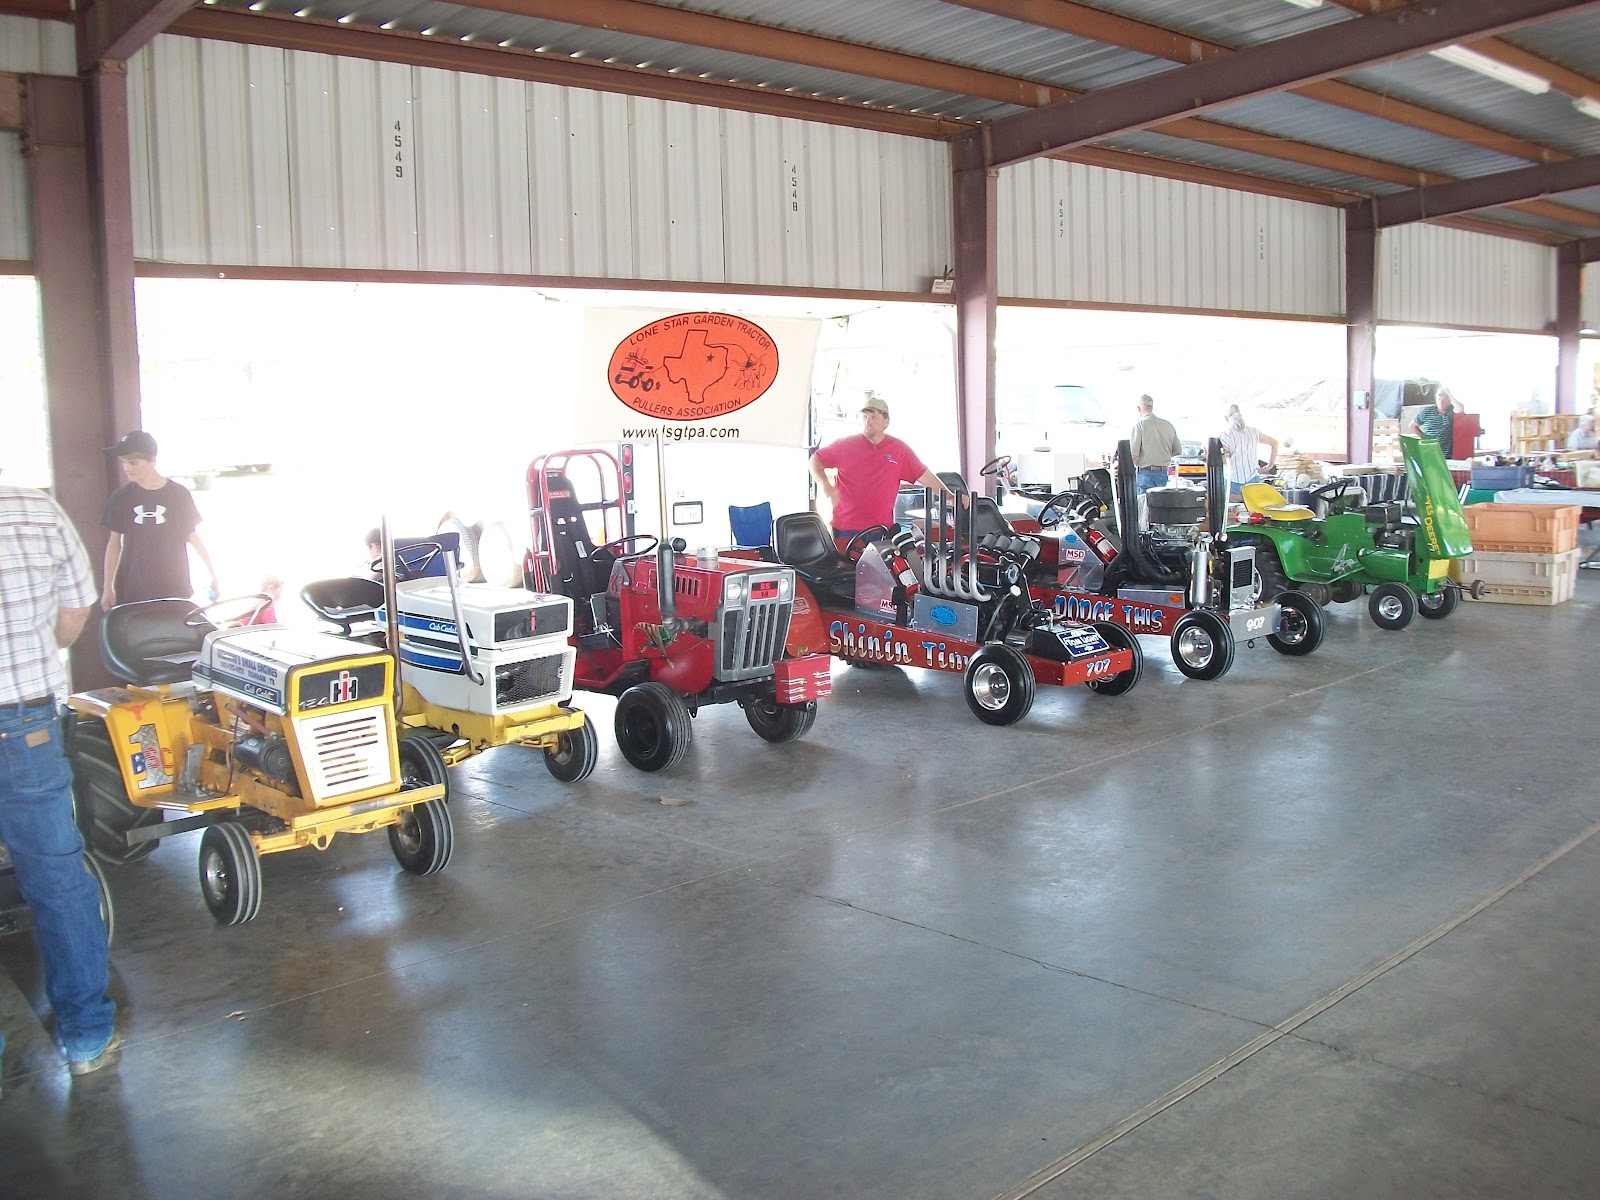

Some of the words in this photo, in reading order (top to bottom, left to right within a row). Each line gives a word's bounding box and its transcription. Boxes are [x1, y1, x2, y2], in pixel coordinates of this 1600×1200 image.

[394, 120, 403, 178] 4549
[629, 325, 660, 346] LONE
[663, 316, 690, 331] STAR
[693, 315, 735, 328] GARDEN
[736, 321, 771, 351] TRACTOR
[632, 396, 674, 416] PULLERS
[676, 398, 742, 417] ASSOCIATION
[622, 424, 741, 441] wwwlsgtpa.com
[1066, 550, 1085, 558] MSD
[760, 582, 771, 590] SS
[1055, 595, 1115, 622] DODGE
[1122, 604, 1163, 633] THIS
[428, 622, 441, 631] Cub
[1246, 617, 1265, 632] 907
[829, 620, 913, 664] Shinin
[921, 641, 970, 671] Tim
[1086, 658, 1111, 677] 707
